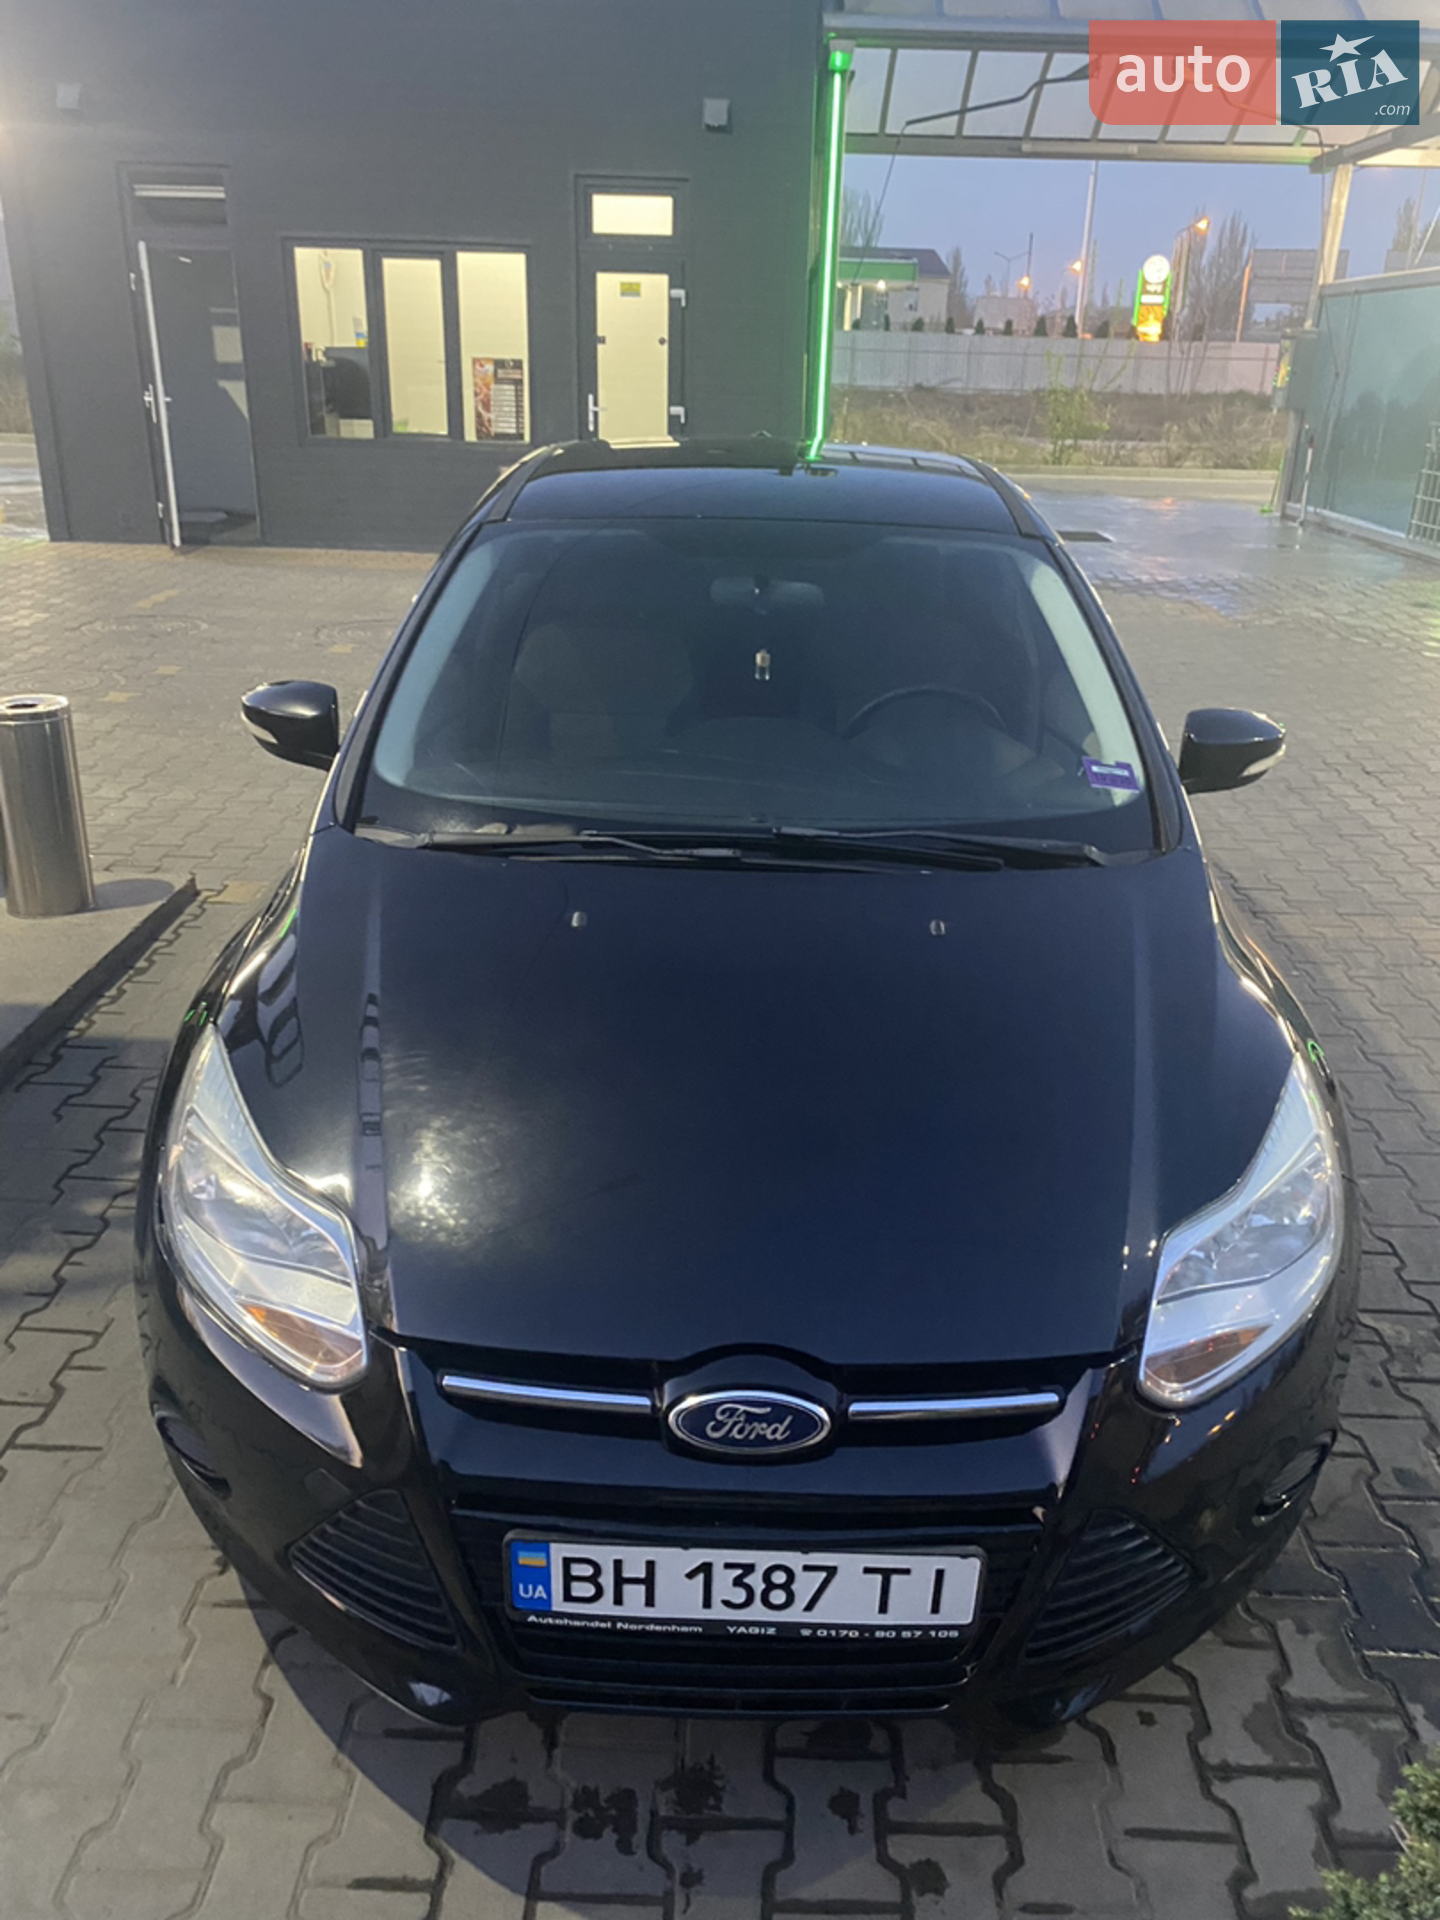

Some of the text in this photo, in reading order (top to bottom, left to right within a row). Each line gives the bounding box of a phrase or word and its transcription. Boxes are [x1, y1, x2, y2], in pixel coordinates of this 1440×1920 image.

[705, 1403, 794, 1441] Ford
[518, 1582, 548, 1600] UA
[561, 1556, 656, 1608] BH
[684, 1562, 838, 1612] 1387
[526, 1614, 612, 1629] Autohandel
[616, 1621, 704, 1633] Nordenham
